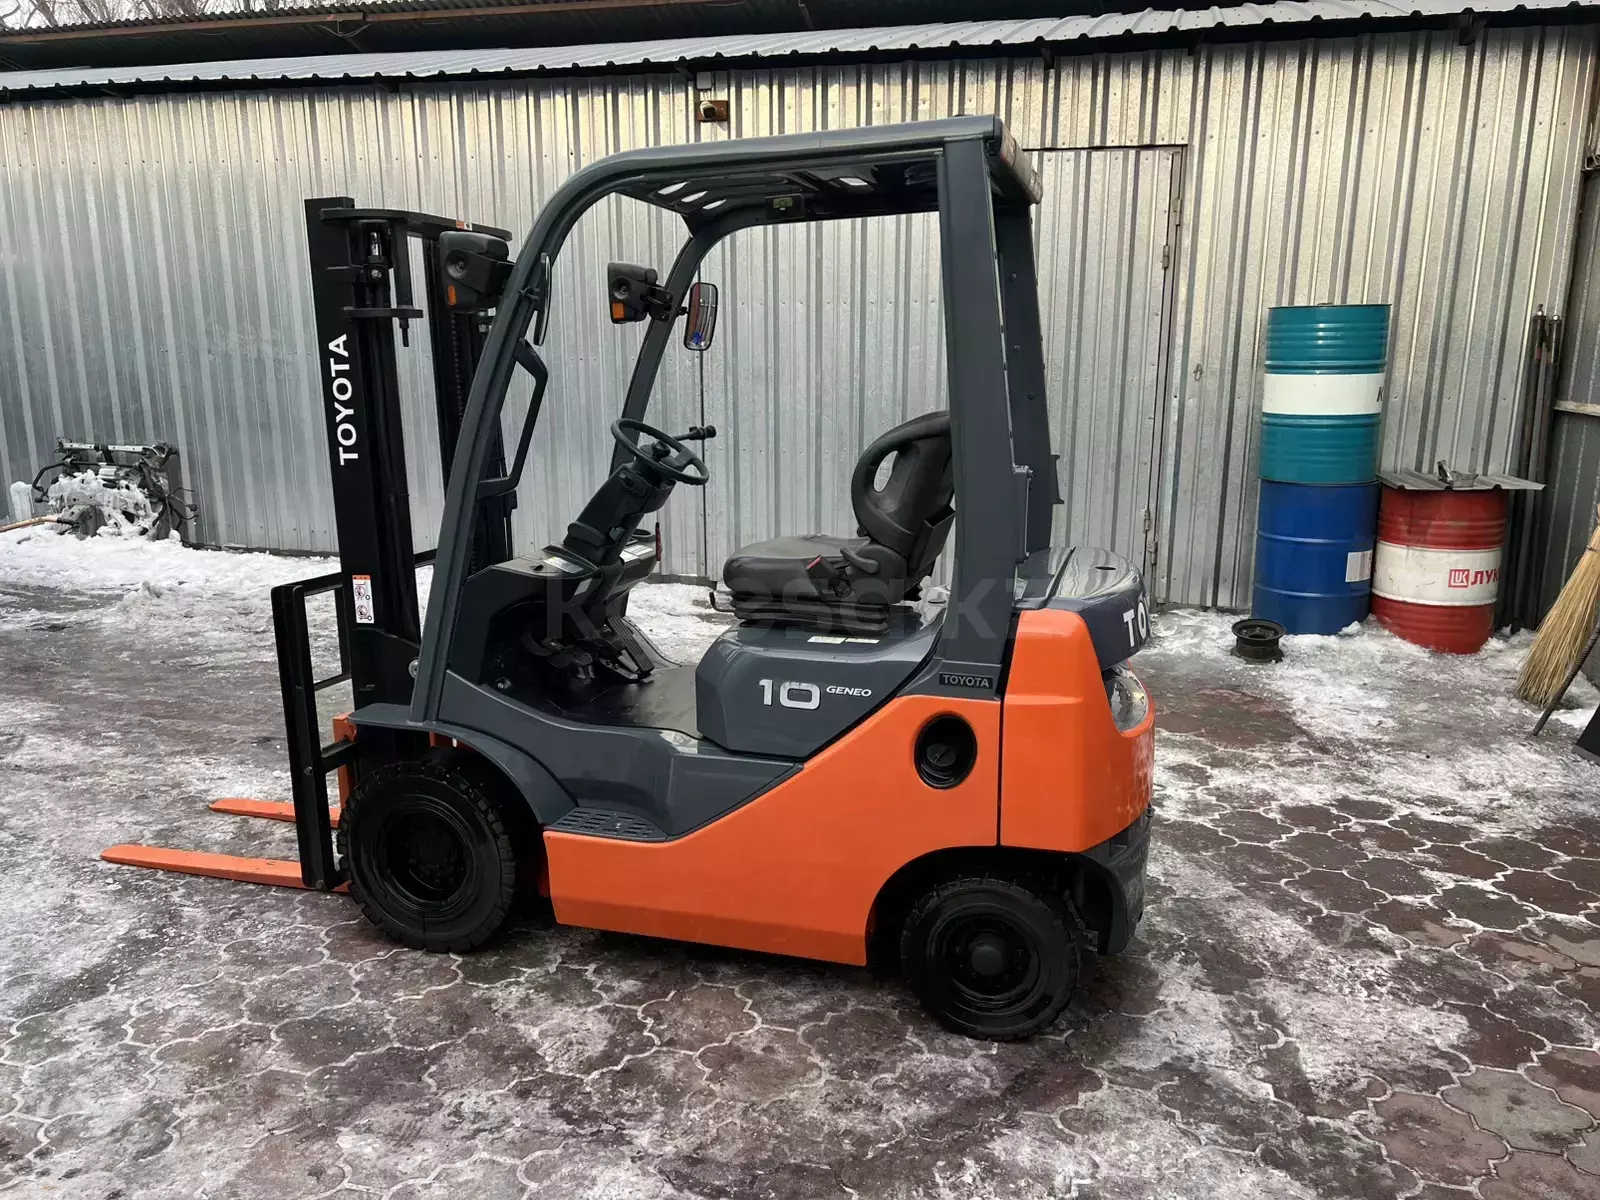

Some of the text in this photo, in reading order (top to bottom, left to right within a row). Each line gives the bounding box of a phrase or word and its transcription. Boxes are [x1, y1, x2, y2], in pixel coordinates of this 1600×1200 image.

[329, 334, 359, 466] TOYOTA
[1471, 569, 1501, 585] ЛУК
[1123, 602, 1147, 647] TO
[759, 679, 872, 710] 10 GENEO
[943, 675, 990, 688] TOYOTA
